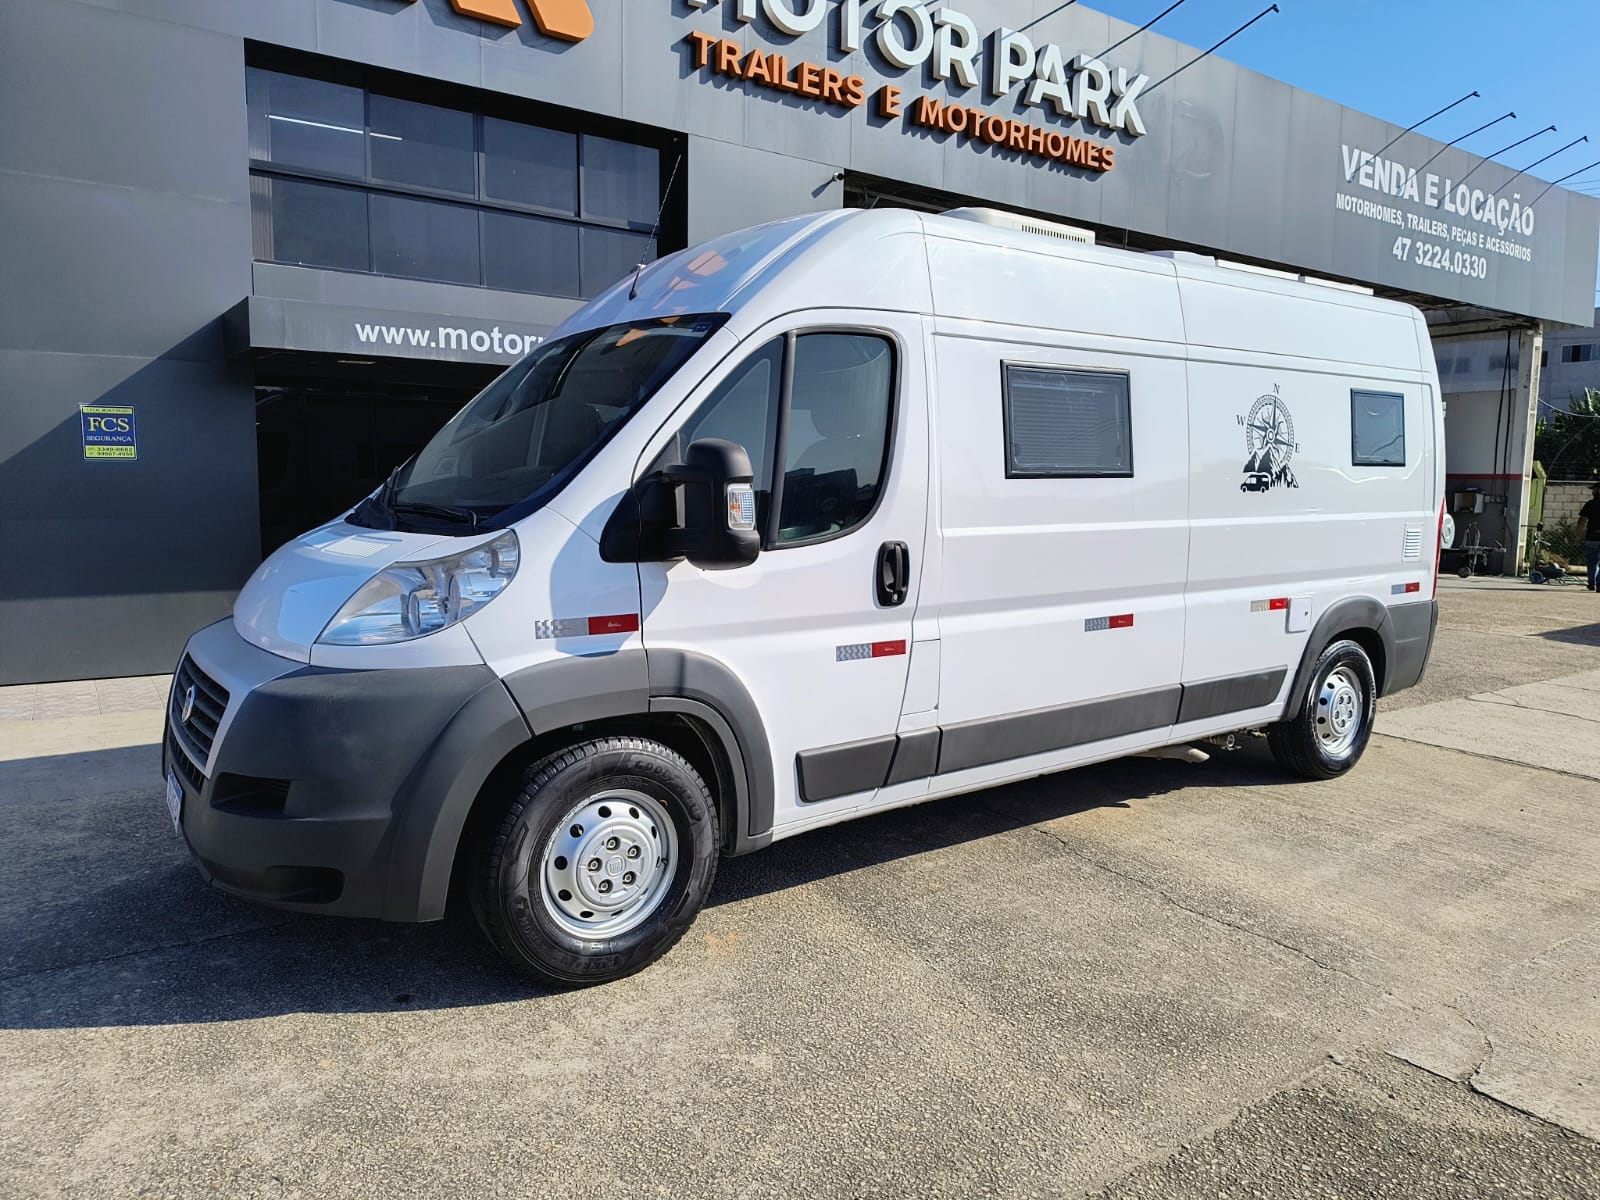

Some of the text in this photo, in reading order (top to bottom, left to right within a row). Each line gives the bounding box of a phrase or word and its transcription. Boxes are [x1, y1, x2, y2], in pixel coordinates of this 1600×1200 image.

[689, 30, 1116, 172] TRAILERS E MOTORHOMES
[993, 26, 1149, 137] PARK
[1341, 144, 1535, 237] VENDA E LOCAÇÃO
[1336, 193, 1532, 262] MOTORHOMES, TRAILERS, PEÇAS E ACESSÓRIOS
[1392, 236, 1487, 280] 47 3224.0330
[355, 323, 546, 355] www.motor
[1273, 383, 1280, 394] N
[88, 417, 130, 433] FCS
[1236, 414, 1246, 426] W
